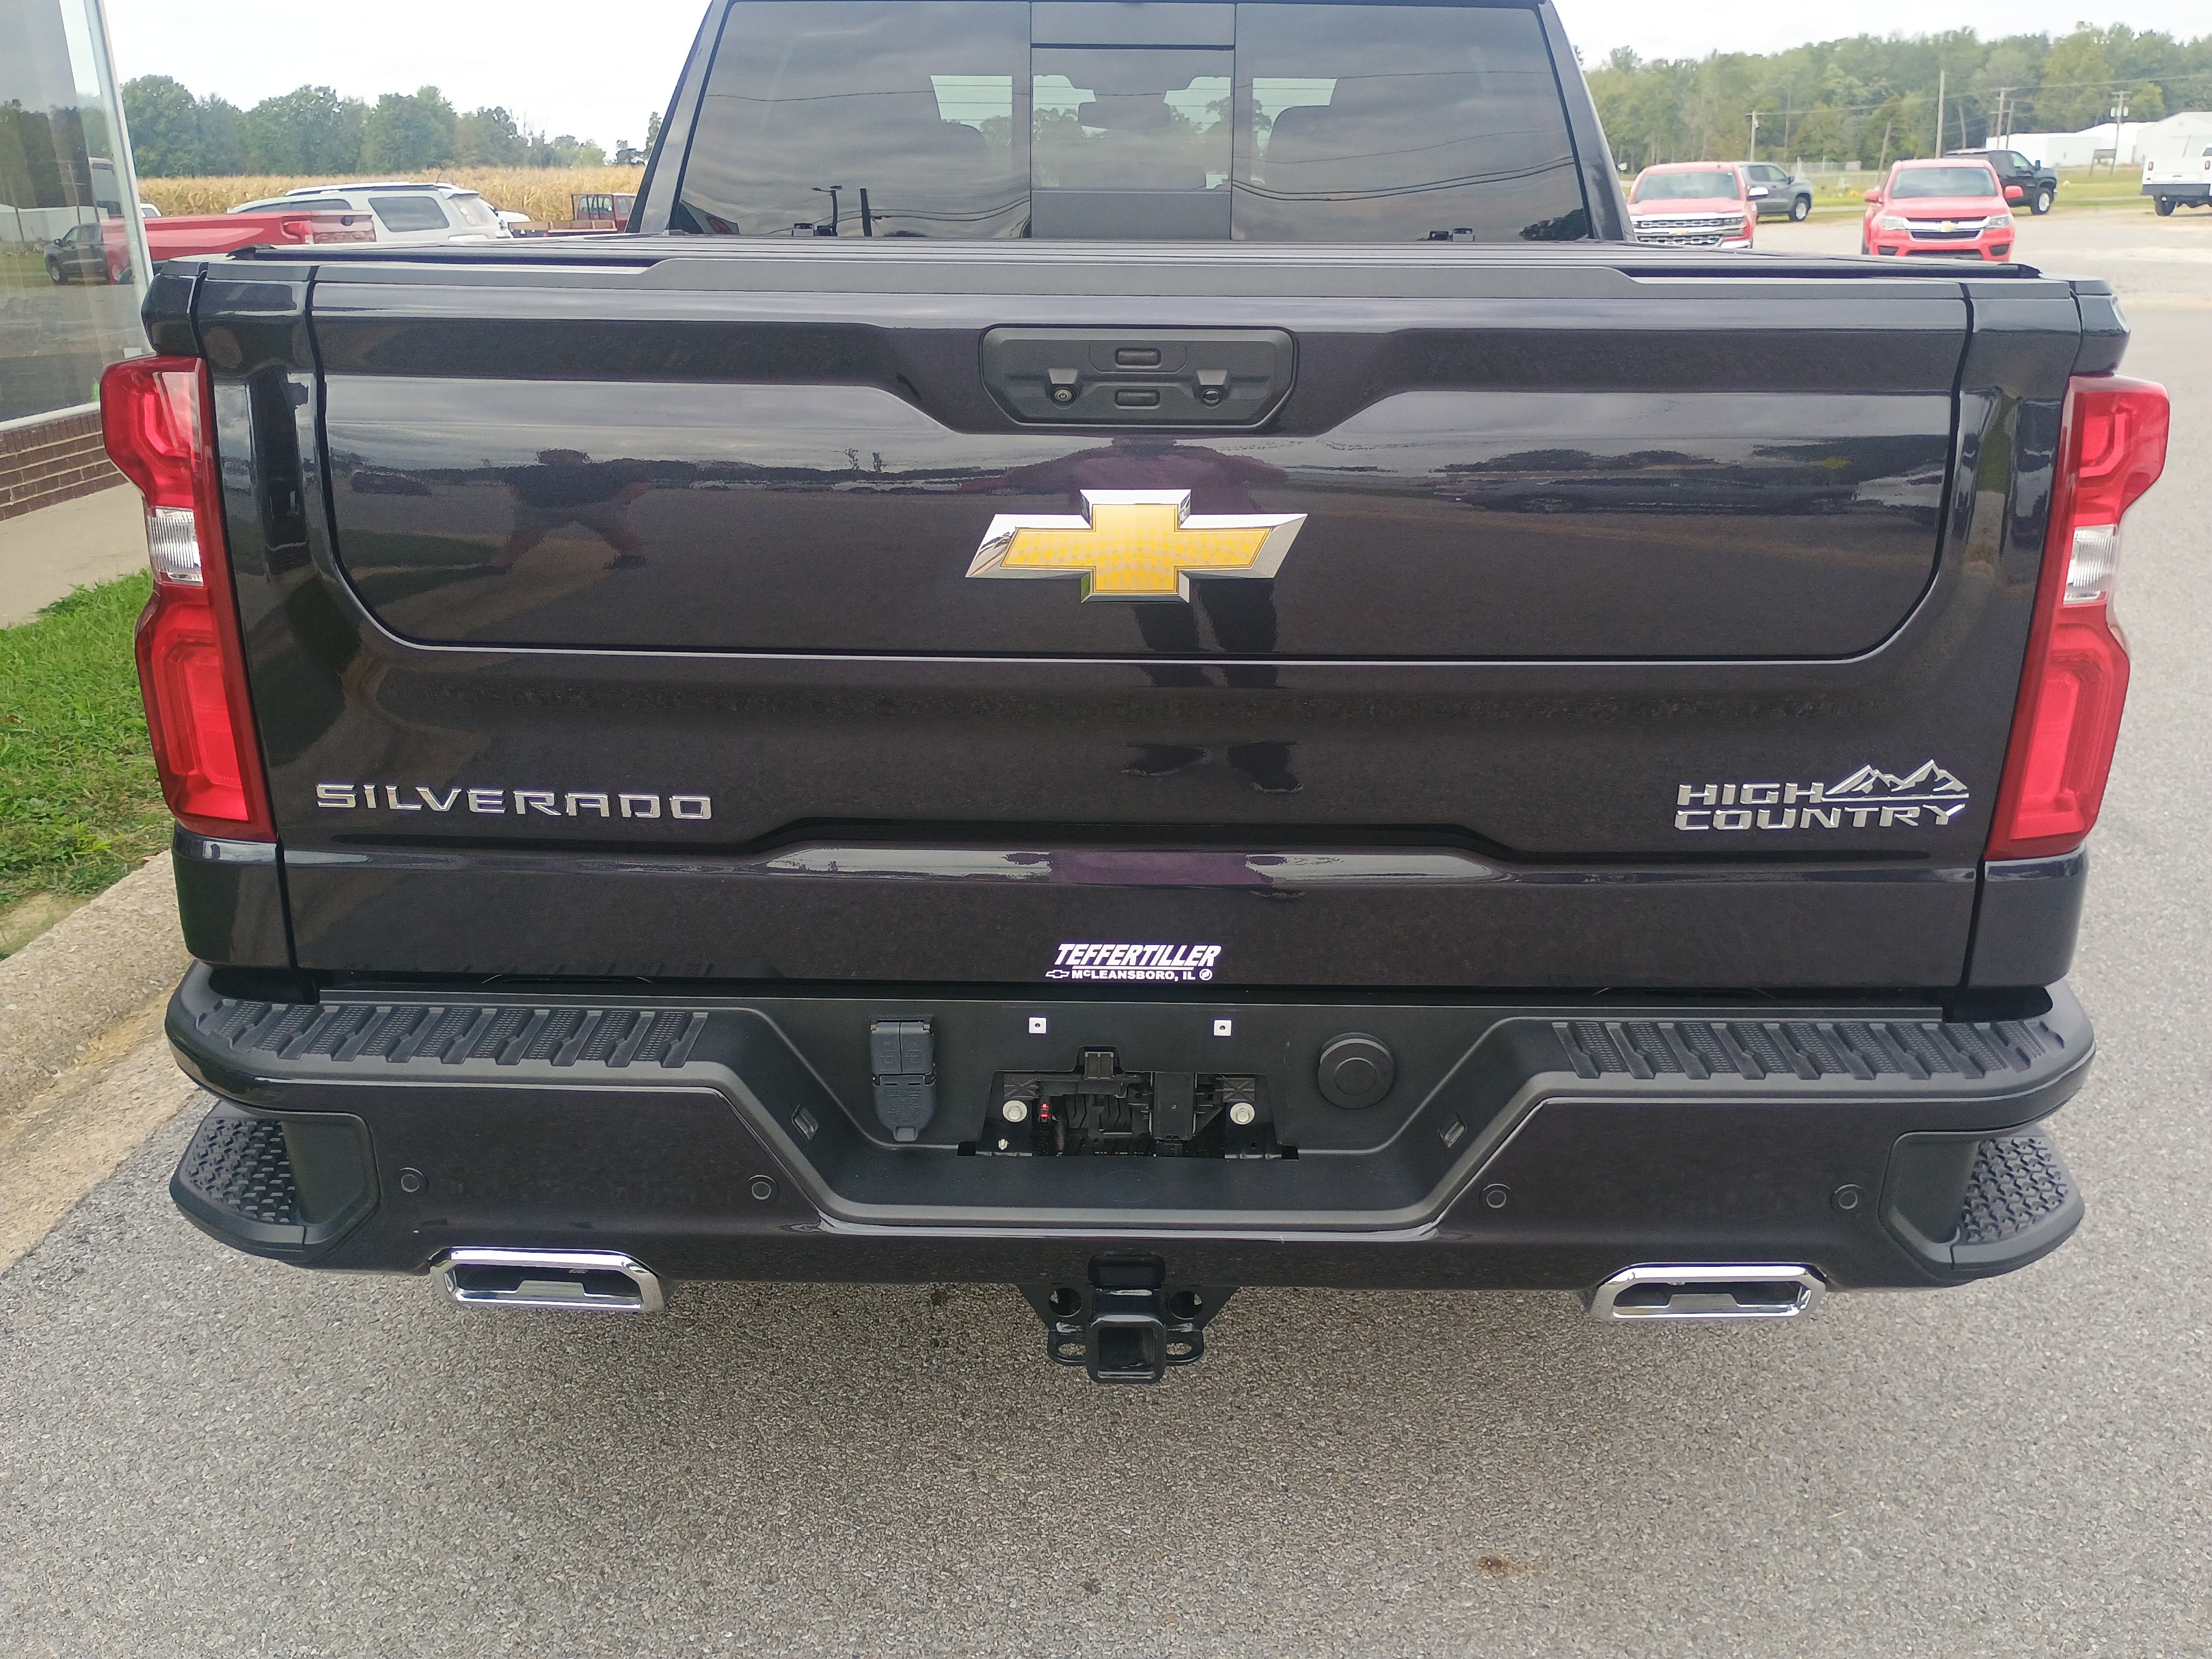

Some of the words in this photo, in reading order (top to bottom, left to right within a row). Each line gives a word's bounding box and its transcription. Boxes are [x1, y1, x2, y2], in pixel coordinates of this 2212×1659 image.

[315, 783, 712, 819] SILVERADO
[1677, 782, 1824, 805] HIGH
[1674, 803, 1966, 830] COUNTRY
[1054, 943, 1222, 967] TEFFERTILLER
[1183, 971, 1196, 980] IL
